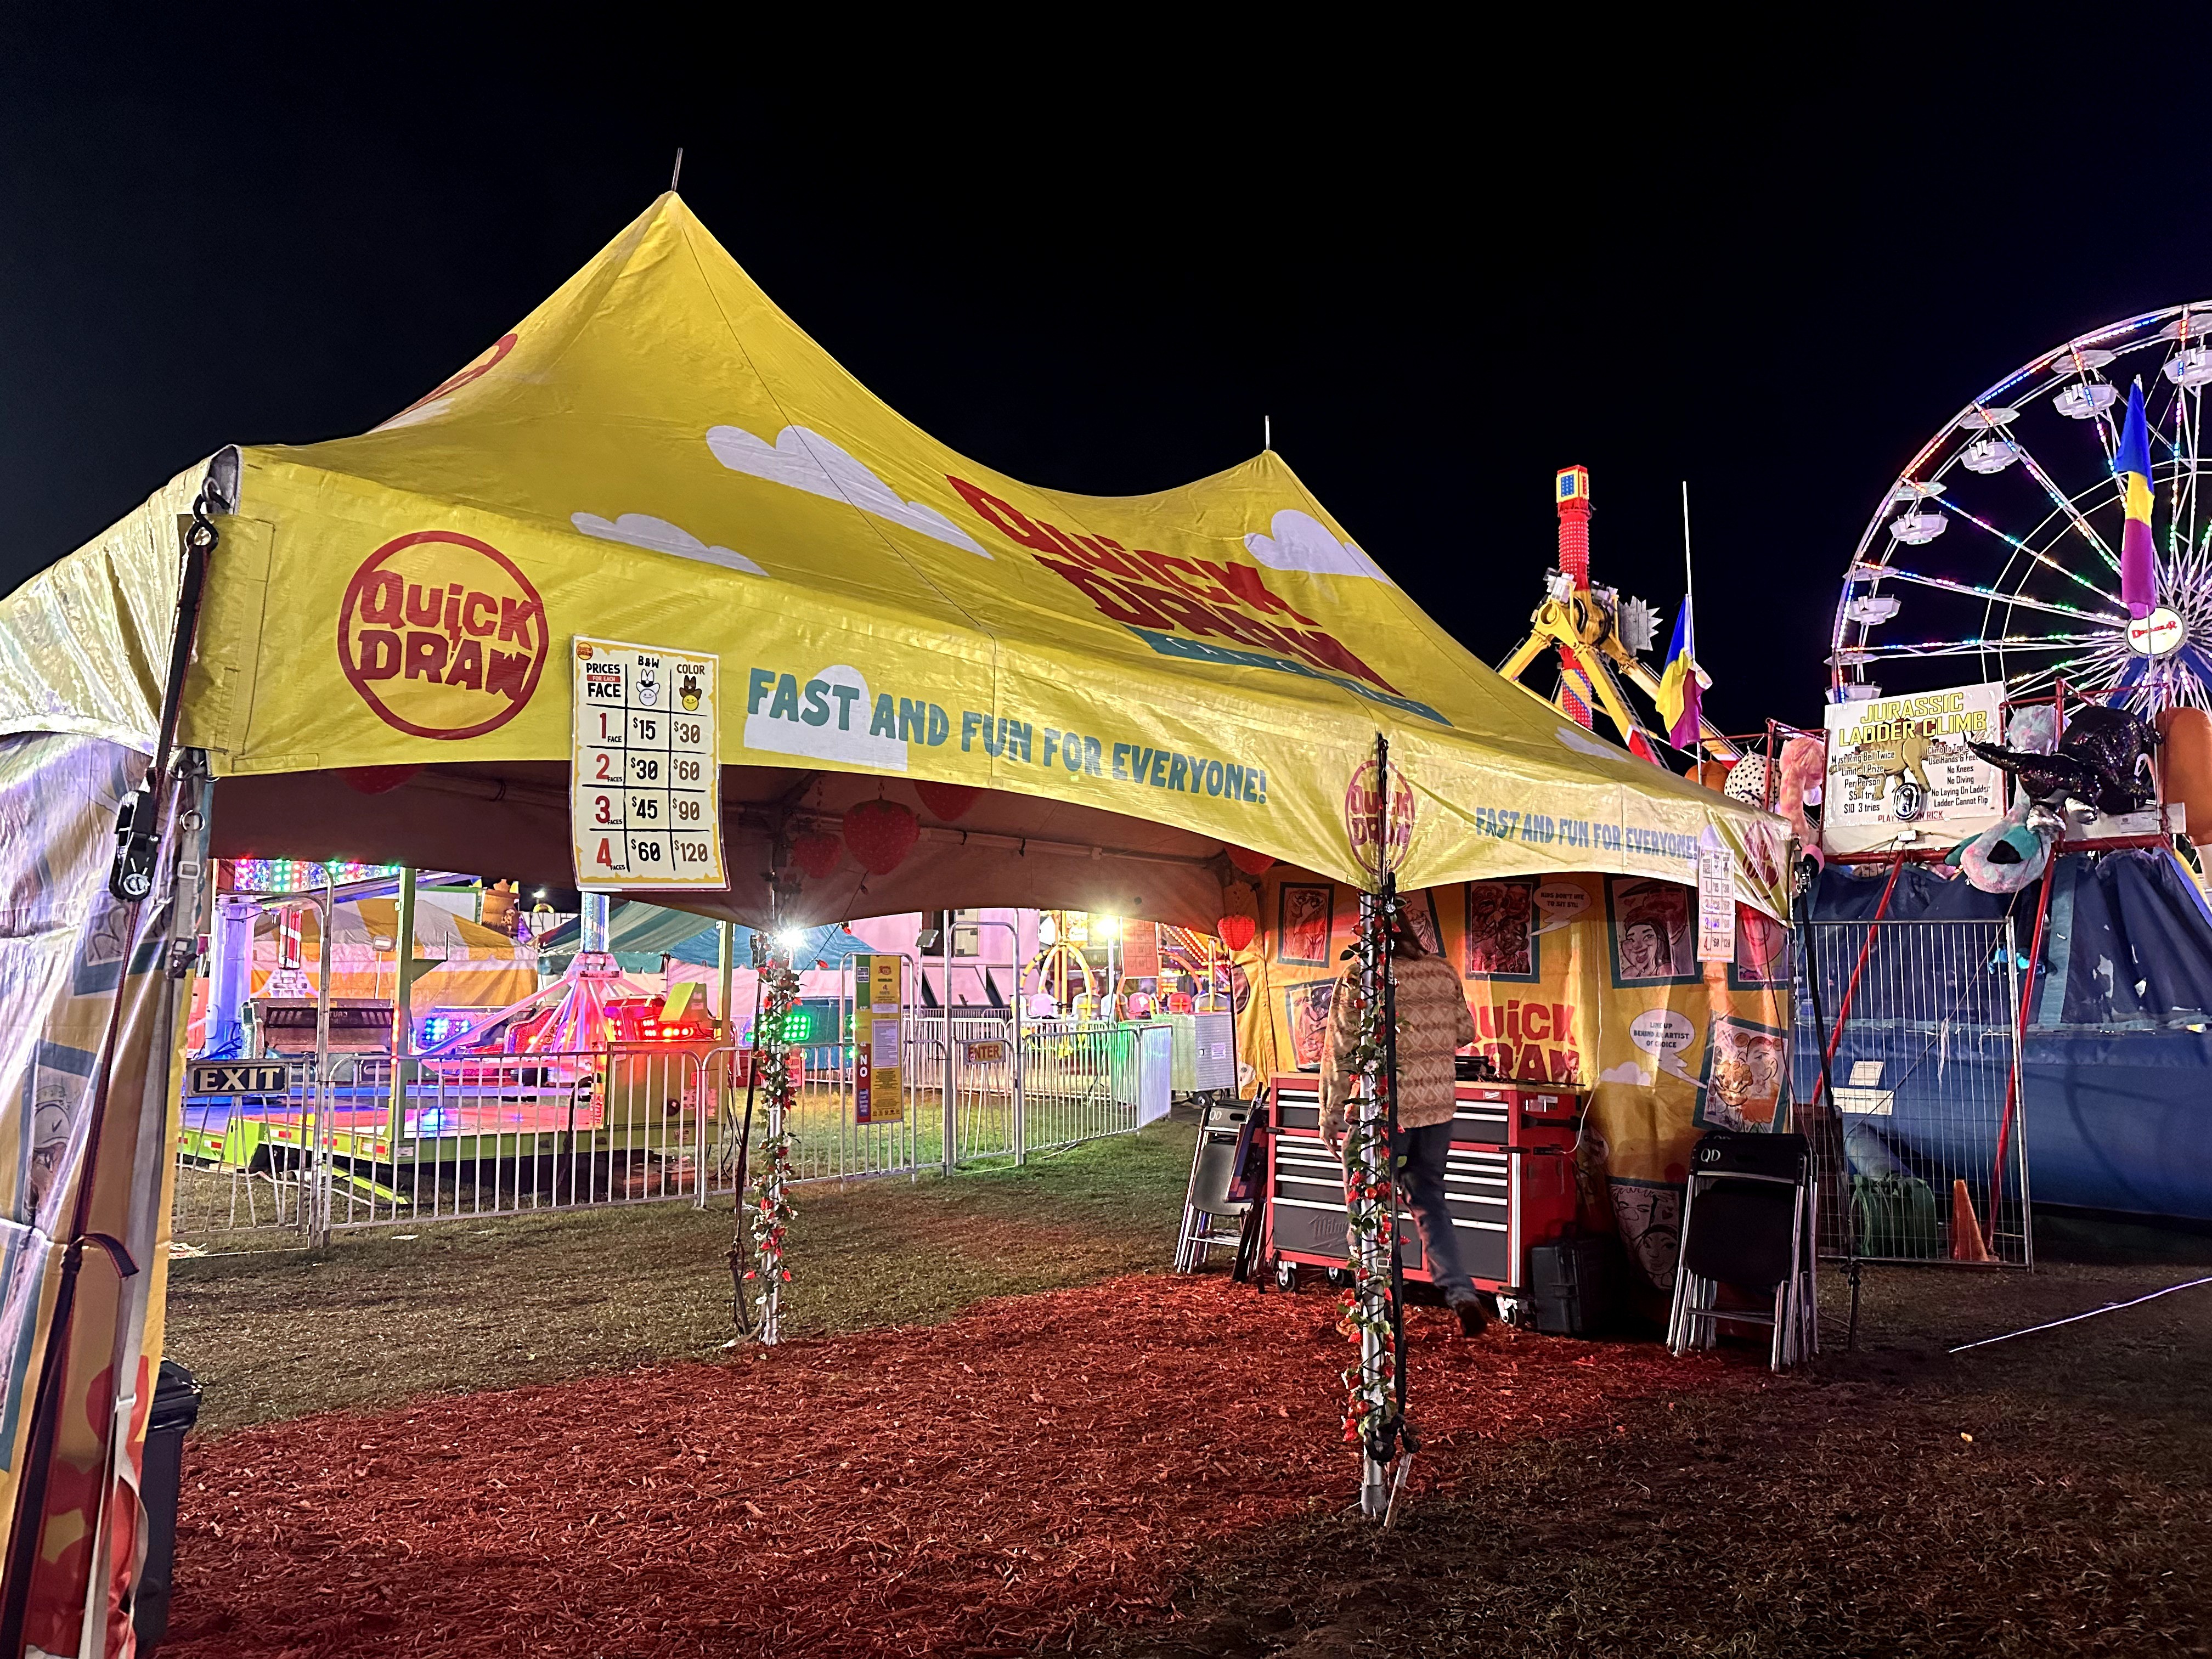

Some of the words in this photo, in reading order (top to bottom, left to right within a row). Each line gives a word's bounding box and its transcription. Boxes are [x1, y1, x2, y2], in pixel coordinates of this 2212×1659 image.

[358, 629, 532, 702] DRAW
[638, 655, 659, 668] B&W
[586, 663, 620, 674] PRICES
[676, 664, 705, 675] COLOR
[588, 682, 621, 698] FACE
[1860, 692, 1964, 724] JURASSIC
[600, 713, 607, 739] 1
[633, 717, 656, 740] $15
[674, 721, 701, 744] $30
[747, 667, 860, 731] FAST
[869, 693, 950, 747] AND
[961, 711, 1032, 763] FUN
[1043, 727, 1103, 776] FOR
[1111, 743, 1267, 804] EVERYONE!
[1839, 719, 1916, 747] LADDER
[1922, 710, 1987, 737] CLIMB
[1928, 746, 1943, 754] Climb
[1945, 744, 1952, 753] To
[1953, 743, 1963, 753] Top
[1848, 753, 1861, 764] Ring
[1863, 751, 1875, 761] Bell
[1877, 750, 1895, 759] Twice
[1928, 757, 1940, 765] Use
[1940, 755, 1958, 764] Hands
[596, 753, 610, 780] 2
[630, 757, 658, 780] $30
[673, 759, 700, 781] $60
[1842, 766, 1857, 776] Limit
[1867, 764, 1884, 774] Prize
[1844, 779, 1857, 788] Per
[1858, 778, 1881, 787] Person
[1956, 776, 1974, 785] Diving
[1865, 791, 1875, 800] try
[1932, 788, 1939, 797] No
[1940, 787, 1959, 798] Laying
[1961, 786, 1968, 794] On
[1970, 785, 1990, 794] Ladder
[1934, 798, 1954, 807] Ladder
[1956, 797, 1976, 805] Cannot
[1978, 795, 1988, 805] Flip
[595, 795, 611, 823] 3
[631, 796, 658, 819] $45
[673, 798, 700, 821] $90
[1844, 803, 1855, 814] $10
[1858, 803, 1863, 812] 3
[1865, 804, 1880, 812] tries
[1926, 810, 1943, 820] RISK
[1475, 807, 1520, 839] FAST
[1521, 813, 1555, 843] AND
[1559, 818, 1589, 848] FUN
[1594, 823, 1622, 851] FOR
[1626, 827, 1698, 860] EVERYONE!
[596, 838, 612, 867] 4
[631, 839, 661, 862] $60
[674, 839, 708, 862] $120
[968, 1045, 1000, 1059] ENTER
[199, 1068, 280, 1091] EXIT
[1209, 1109, 1222, 1121] QD
[1701, 1148, 1721, 1163] QD
